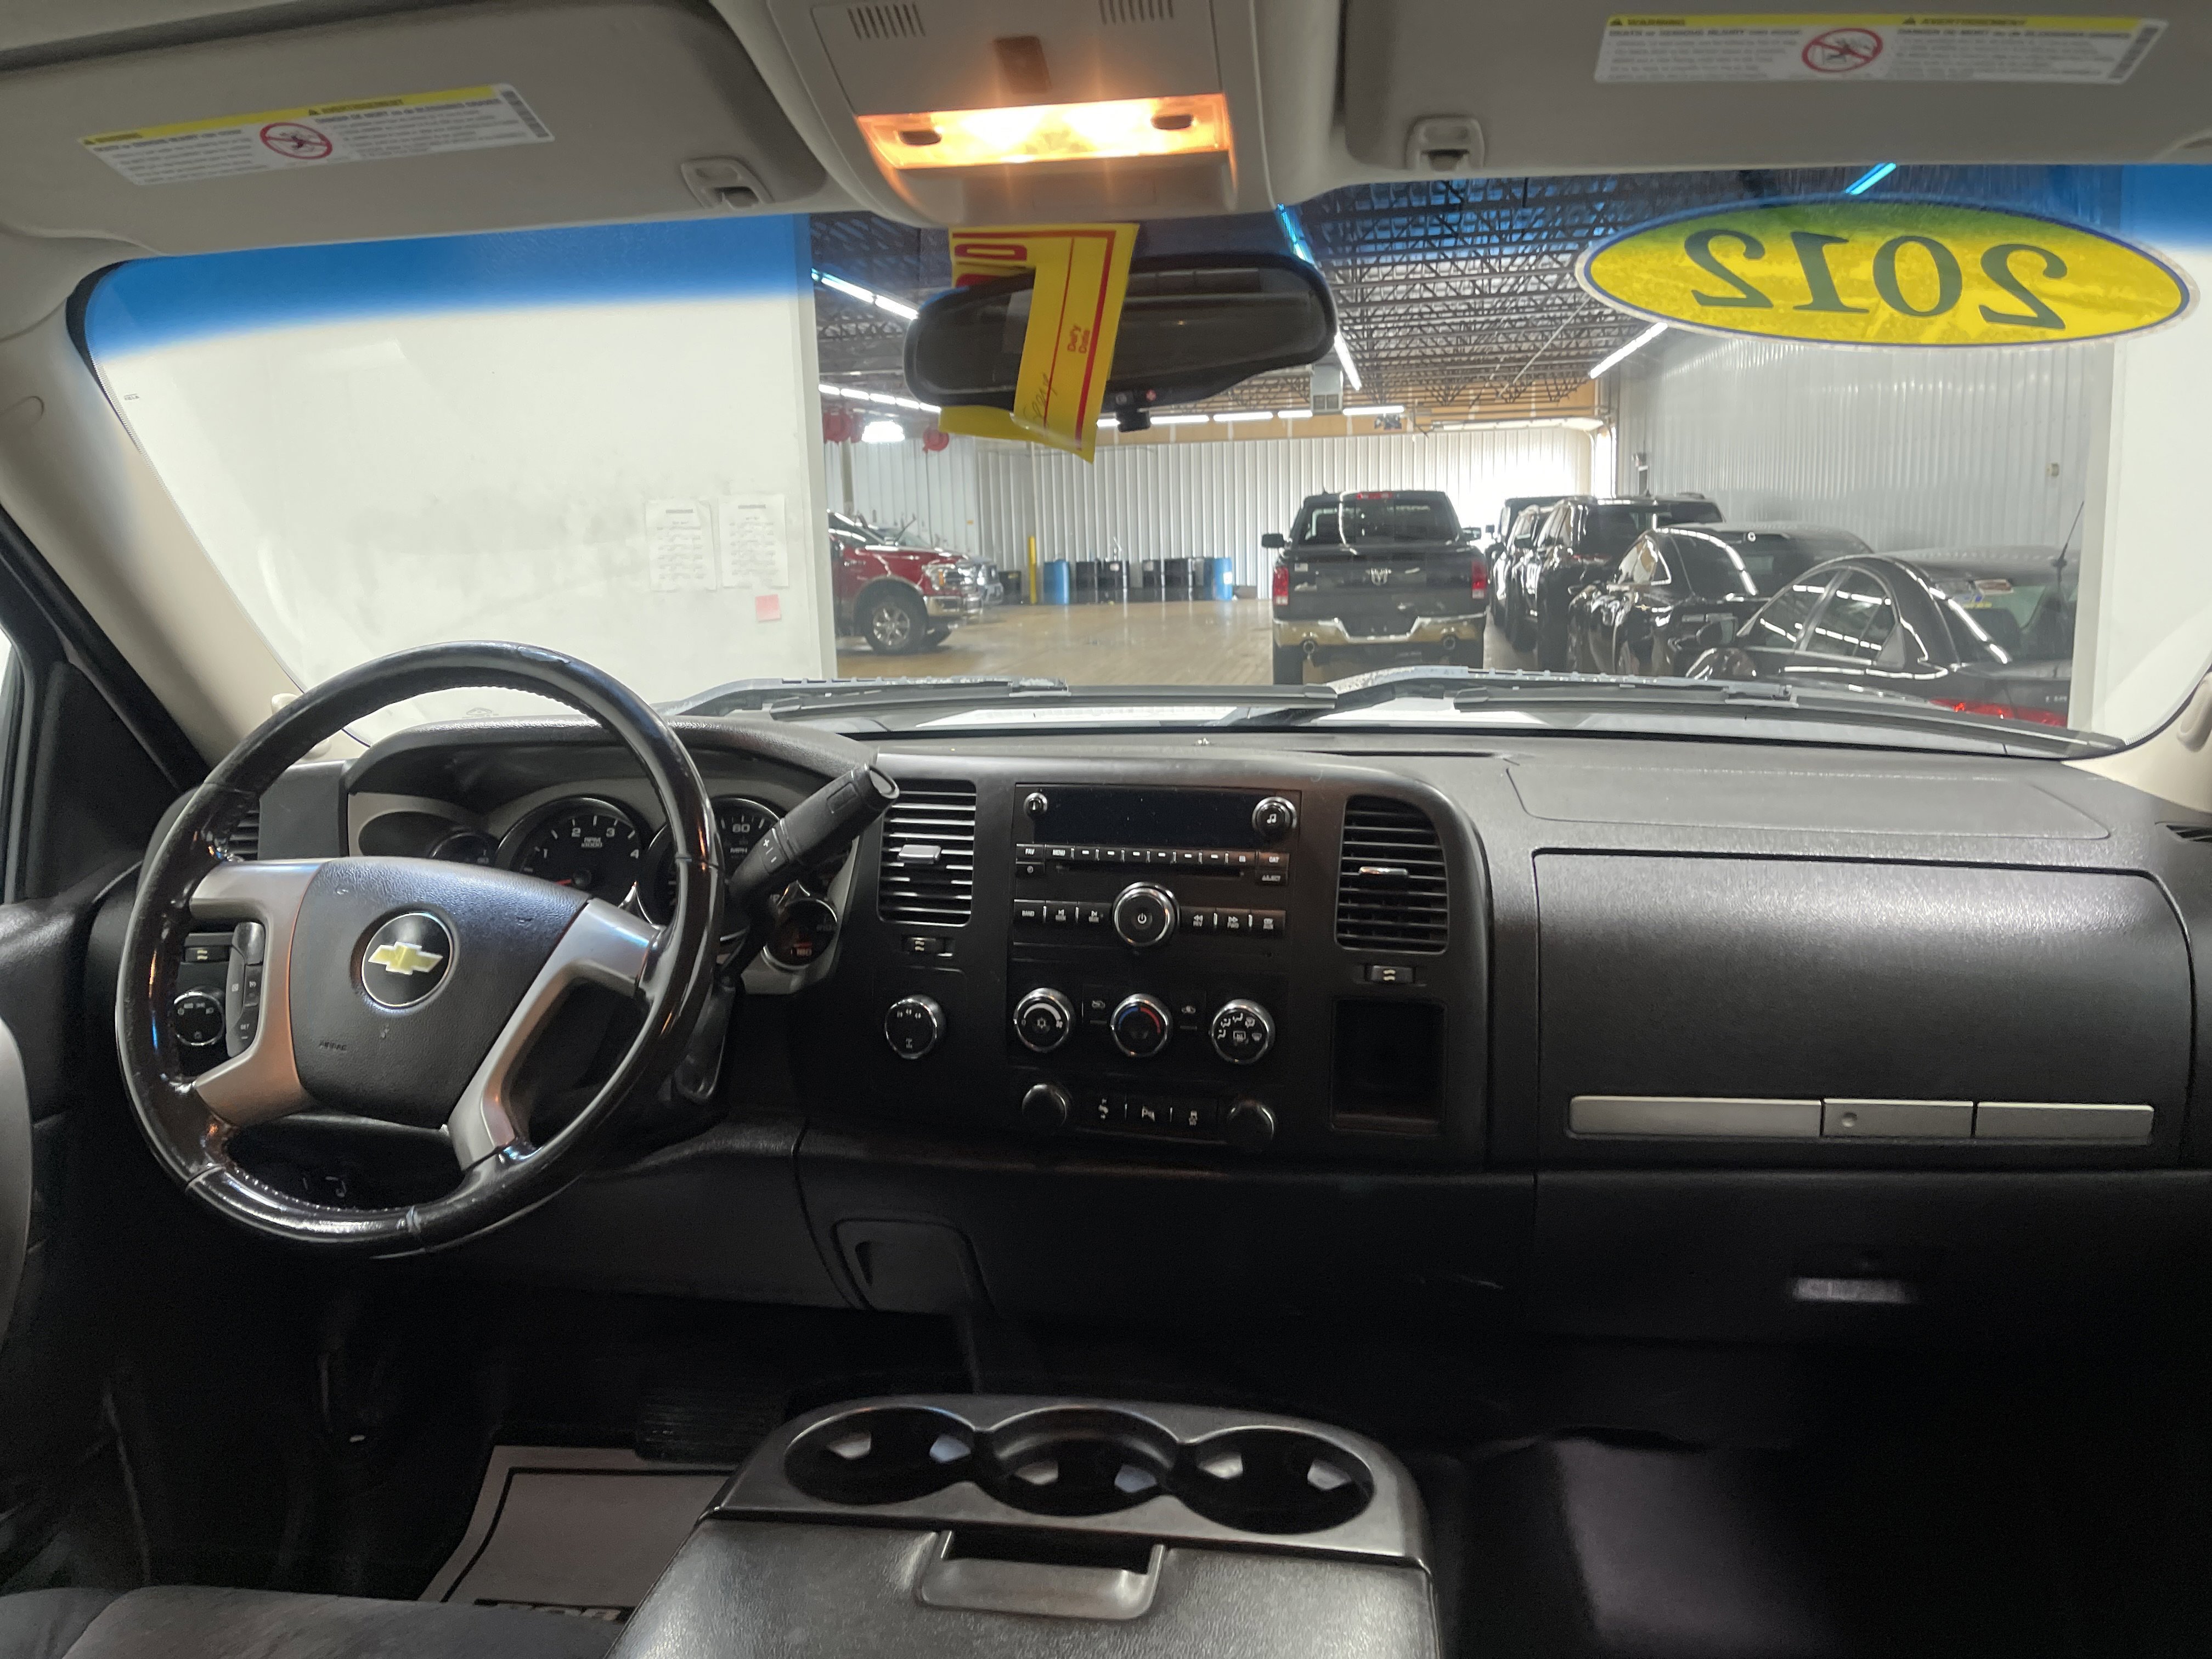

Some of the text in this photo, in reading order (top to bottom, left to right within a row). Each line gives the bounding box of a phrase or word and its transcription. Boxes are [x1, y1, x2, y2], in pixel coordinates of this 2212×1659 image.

[571, 827, 582, 838] 2
[606, 827, 615, 838] 3
[543, 848, 548, 859] 1
[630, 849, 639, 859] 4
